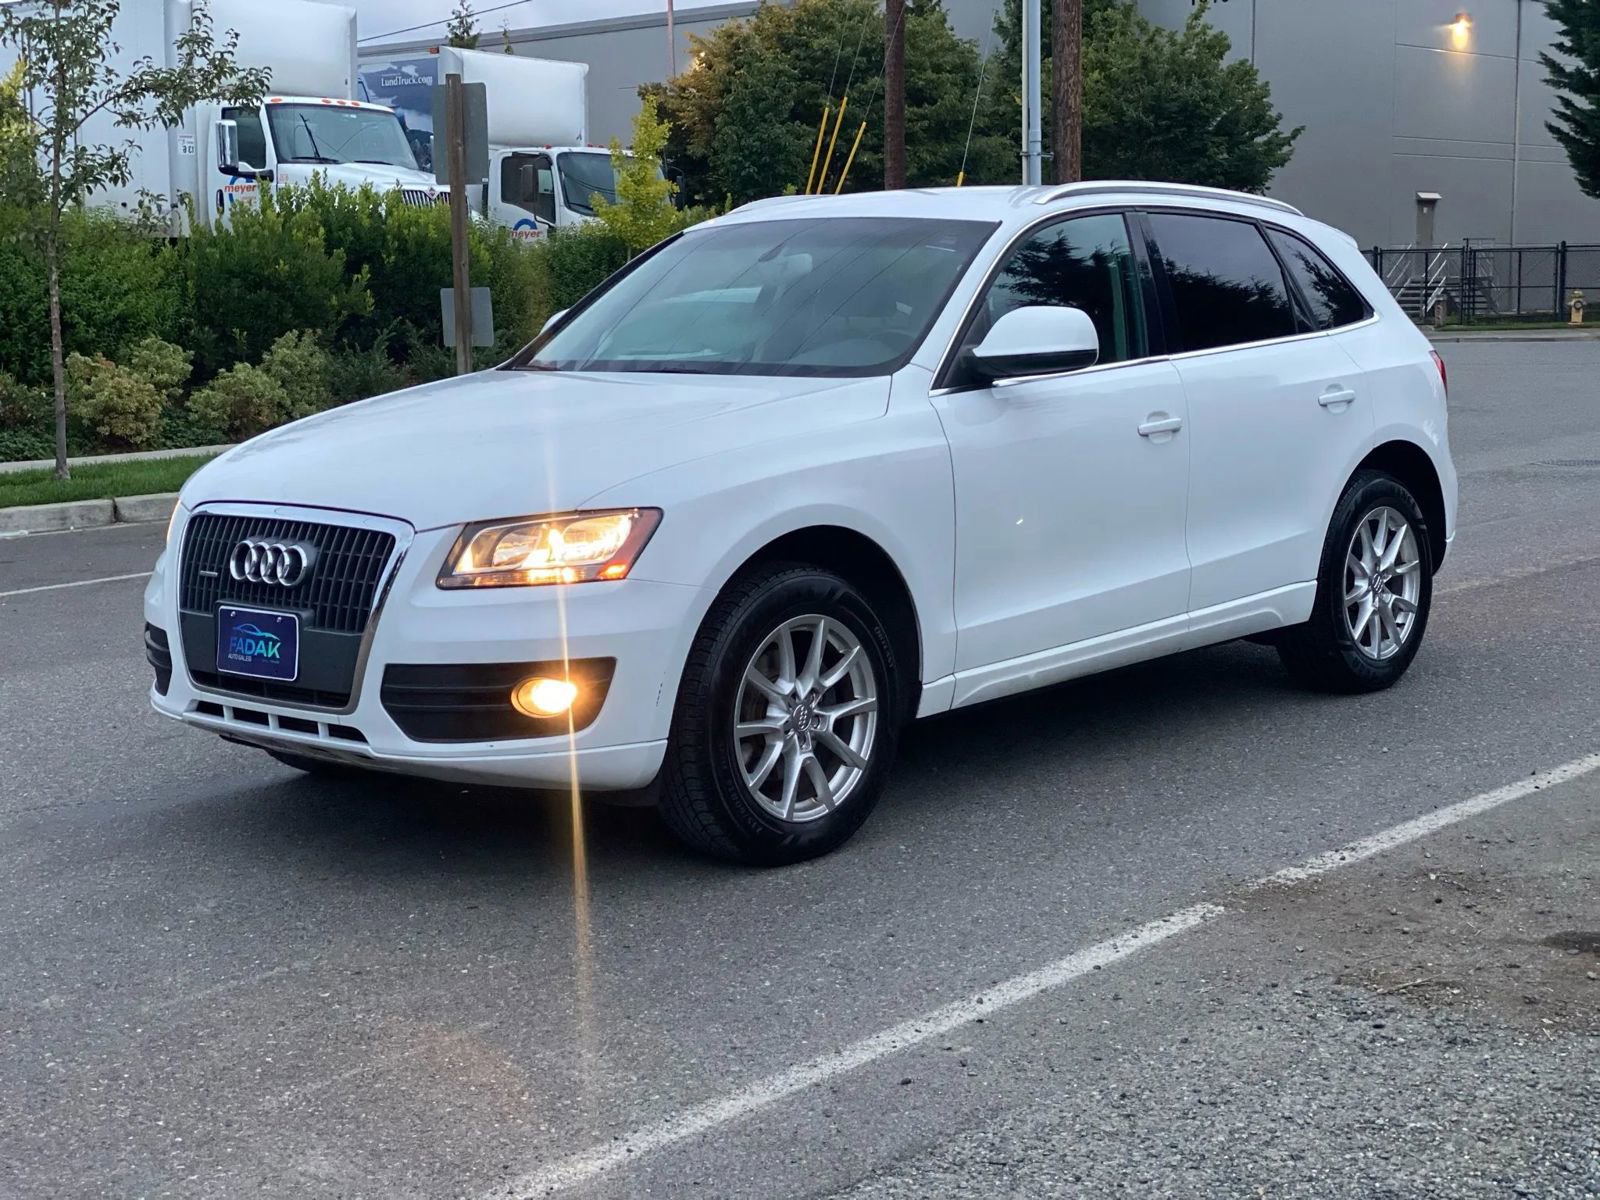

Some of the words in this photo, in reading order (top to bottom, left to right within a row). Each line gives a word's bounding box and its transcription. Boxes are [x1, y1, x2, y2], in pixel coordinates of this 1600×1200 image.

[381, 76, 432, 86] LundTruck.com
[224, 184, 257, 194] meyer
[230, 637, 281, 659] FADAK
